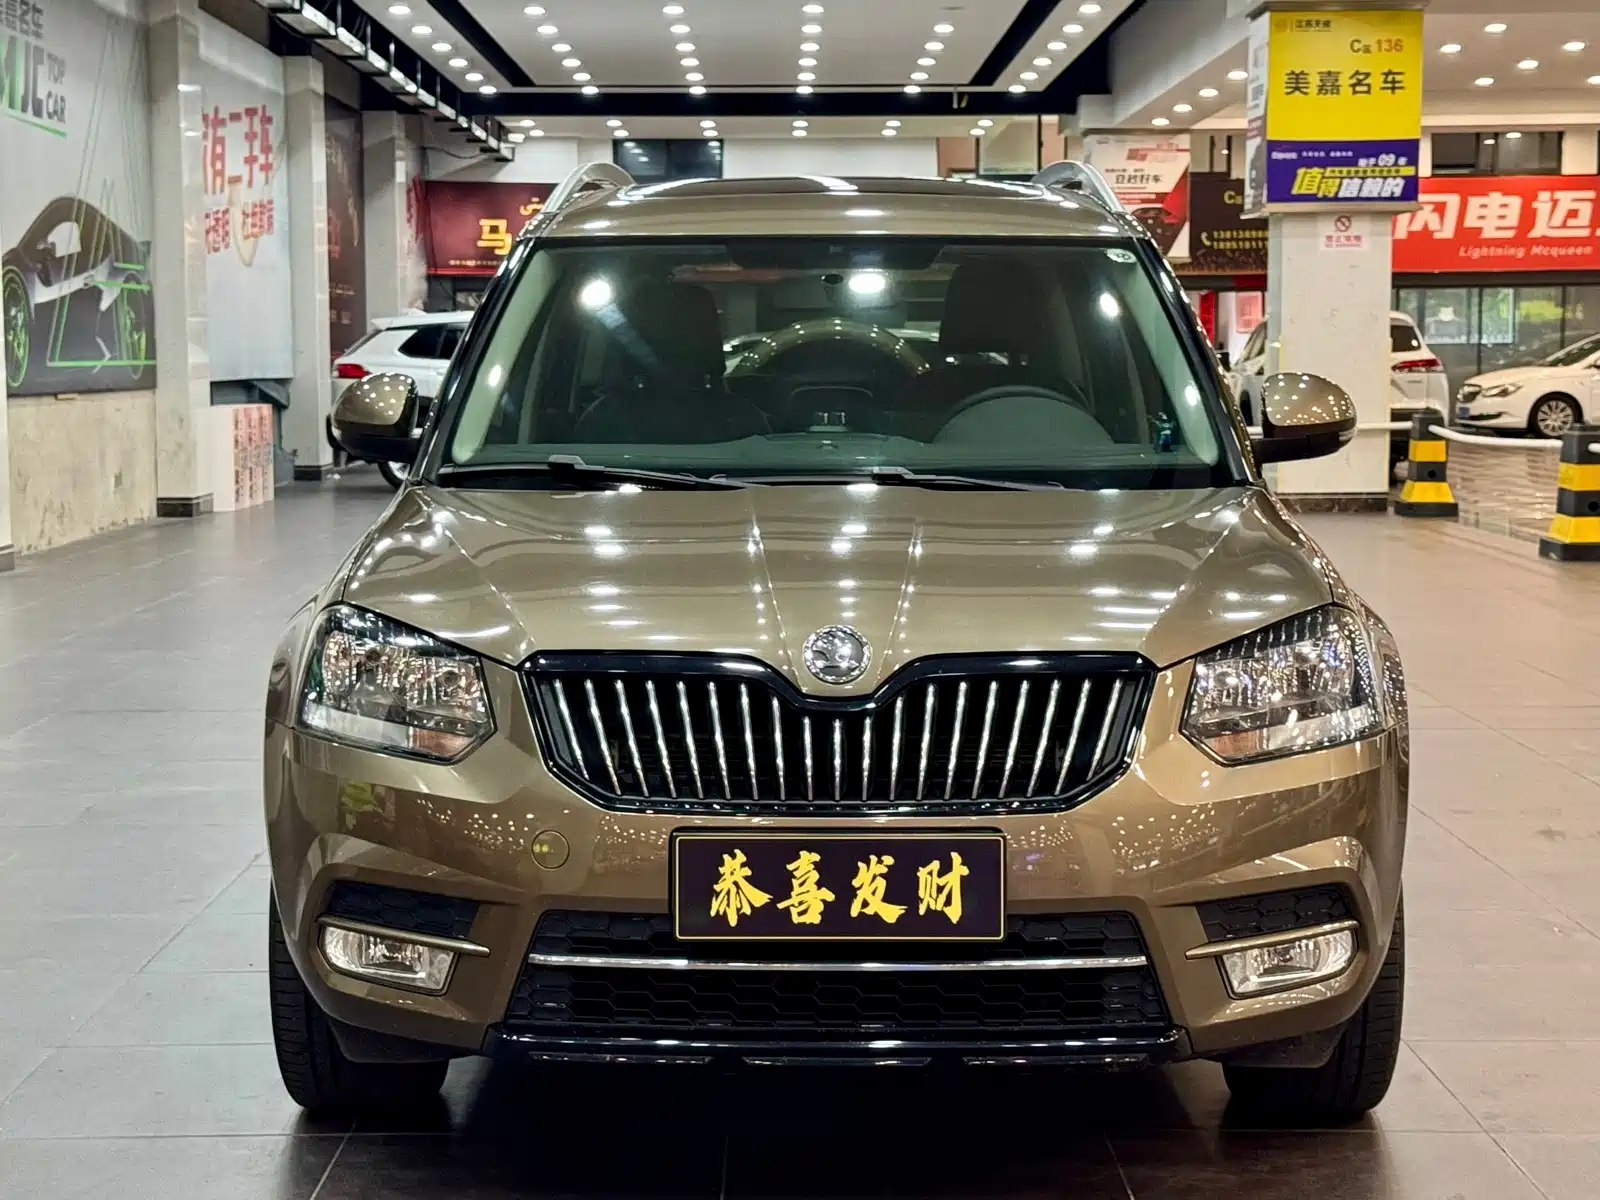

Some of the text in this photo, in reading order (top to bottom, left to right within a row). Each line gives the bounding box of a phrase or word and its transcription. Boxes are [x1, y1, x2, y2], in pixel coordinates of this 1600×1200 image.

[1375, 38, 1404, 53] 136
[1284, 69, 1406, 96] 美嘉名车
[46, 90, 66, 124] CAR
[1393, 190, 1600, 240] 闪电迈
[1458, 245, 1526, 259] Lightning
[709, 849, 970, 927] 恭喜发财
